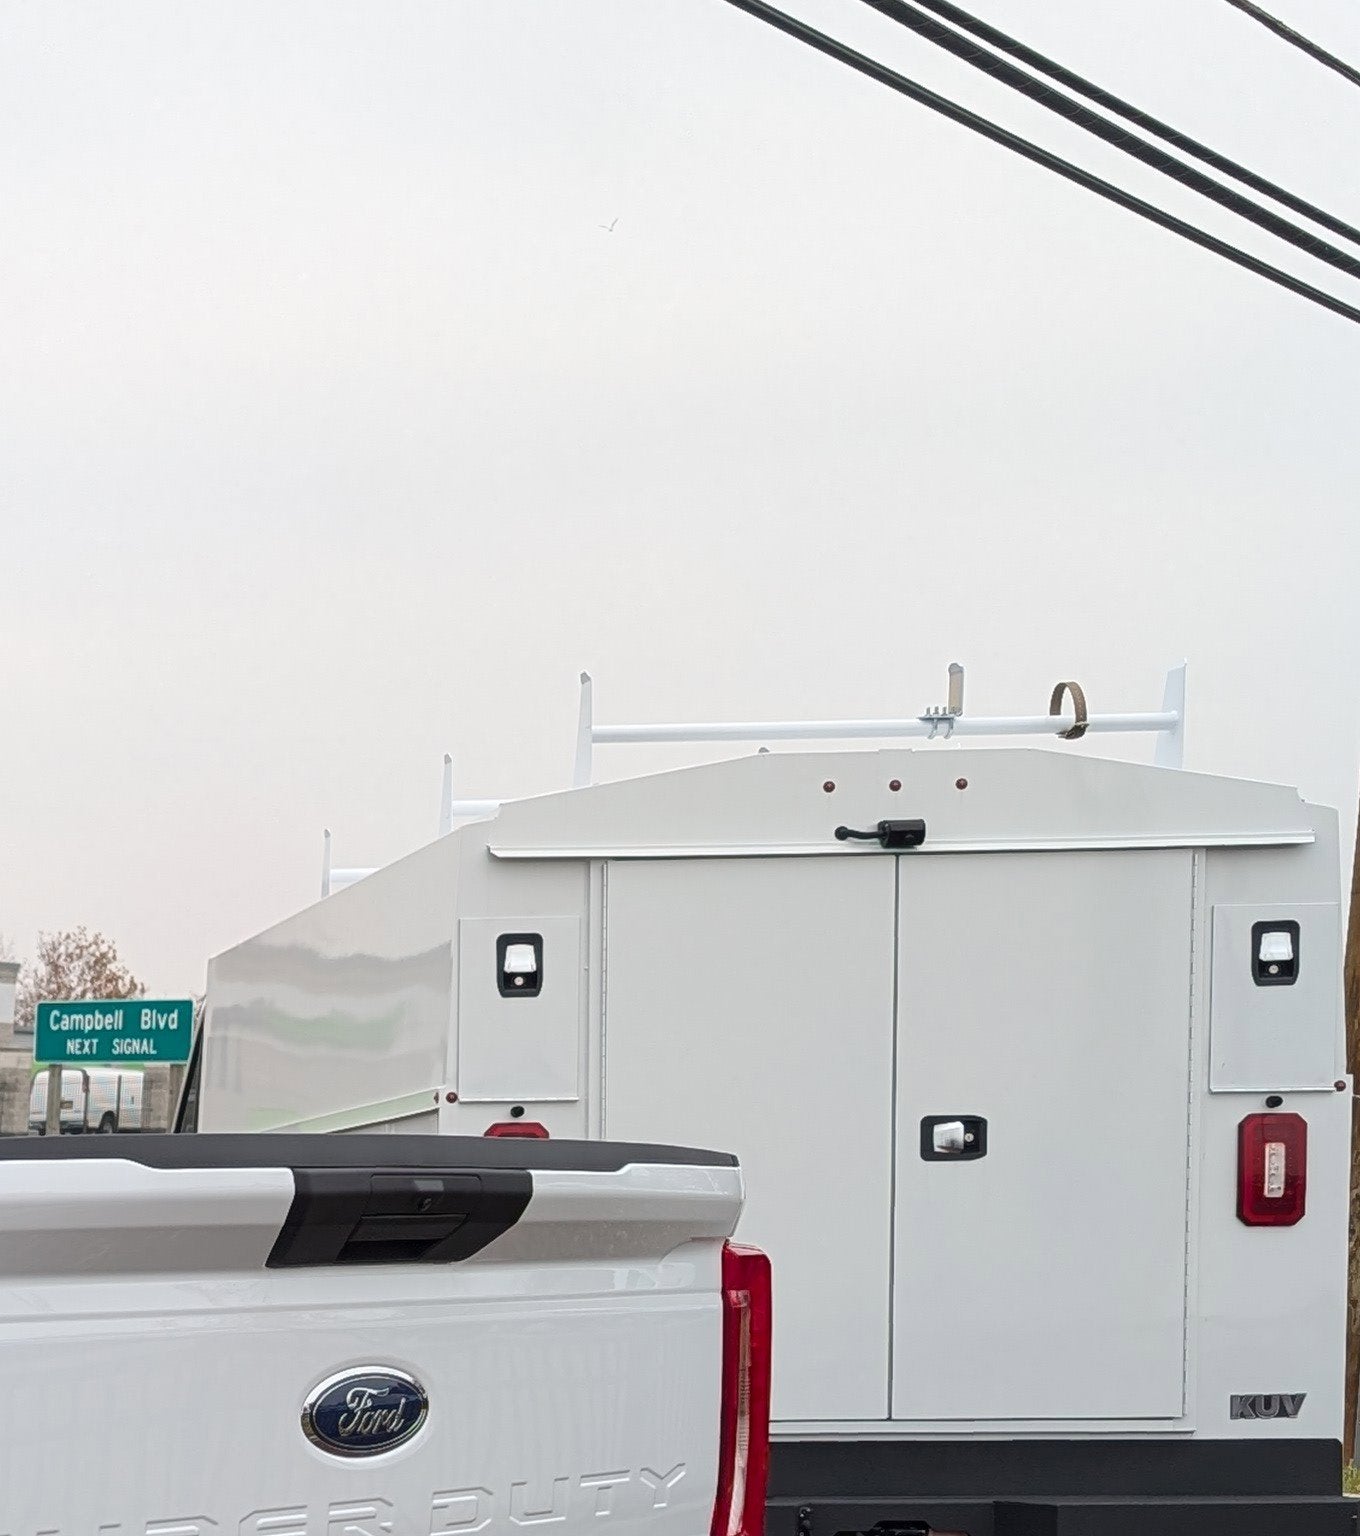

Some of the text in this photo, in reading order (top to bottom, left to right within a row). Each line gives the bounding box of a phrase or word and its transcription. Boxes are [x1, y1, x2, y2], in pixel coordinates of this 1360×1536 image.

[49, 1008, 178, 1033] Campbell Blvd
[66, 1038, 157, 1055] NEXT SIGNAL
[338, 1386, 407, 1437] Ford
[1230, 1392, 1308, 1420] KUV
[430, 1463, 686, 1536] DUTY
